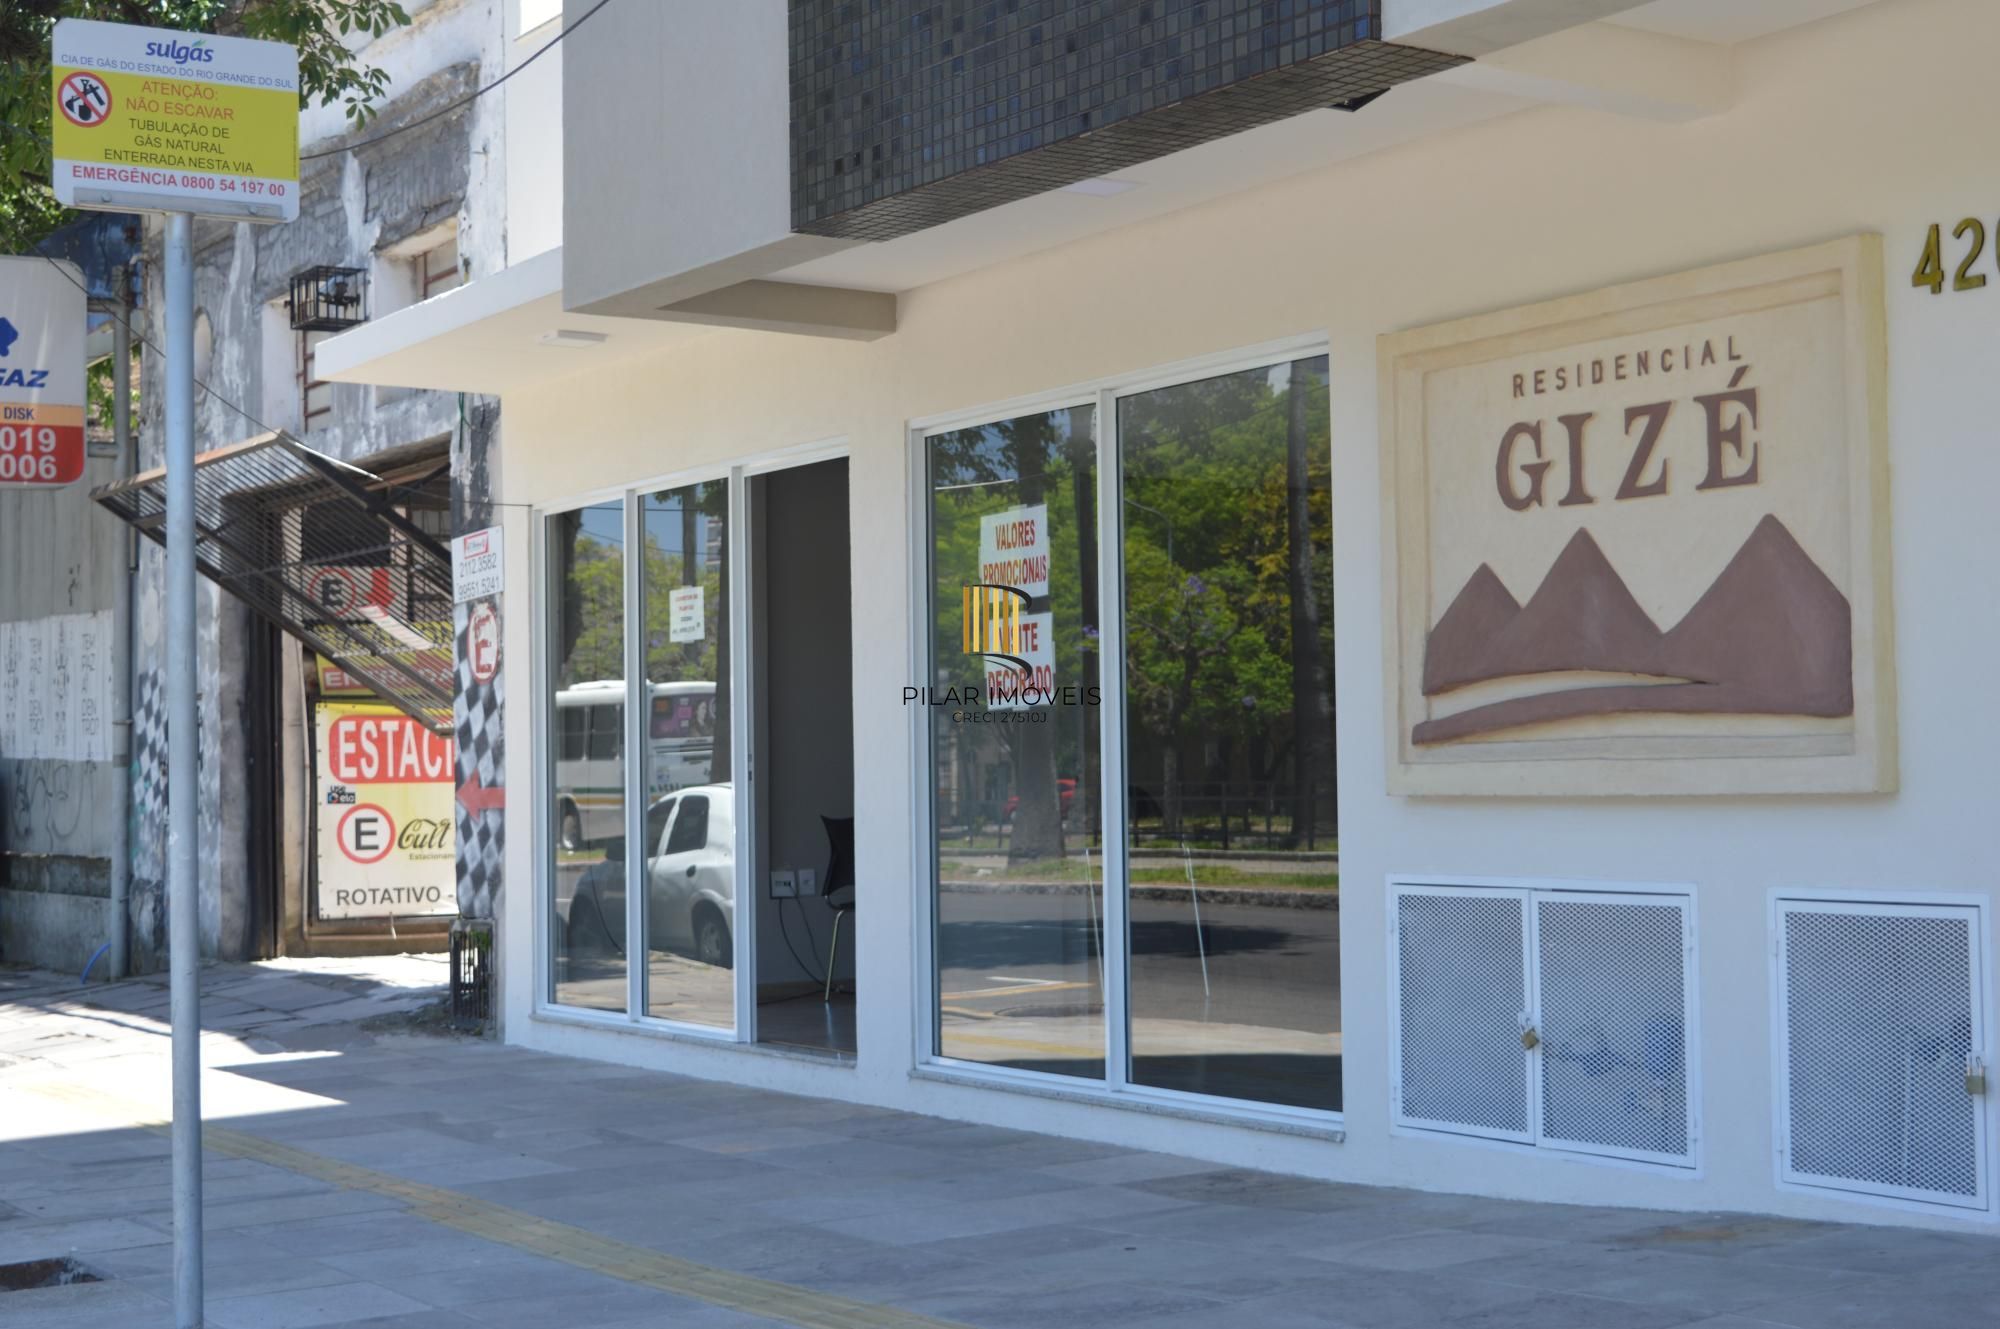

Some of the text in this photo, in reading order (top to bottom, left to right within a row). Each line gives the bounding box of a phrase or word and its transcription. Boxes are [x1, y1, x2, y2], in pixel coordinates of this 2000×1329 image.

[61, 54, 78, 64] CIA
[80, 57, 94, 66] DE
[120, 61, 135, 71] DO
[138, 63, 177, 76] ESTADO
[179, 67, 193, 77] DO
[196, 69, 213, 80] RIO
[216, 72, 256, 85] GRANDE
[258, 76, 272, 86] DO
[275, 79, 293, 89] SUL
[126, 97, 234, 121] NÃO ESCAVAR
[129, 118, 230, 139] TUBULAÇÃO DE
[134, 134, 225, 155] GÁS NATURAL
[104, 148, 255, 174] ENTERRADA NESTA VIA
[72, 165, 286, 197] EMERGÊNCIA 0800 54 197 00
[1912, 217, 2000, 294] 42
[1513, 335, 1743, 398] RESIDENCIAL
[4, 407, 34, 420] DISK
[0, 426, 57, 453] 019
[1495, 364, 1761, 513] GIZÉ
[0, 453, 57, 480] 006
[995, 519, 1036, 551] VALORES
[983, 555, 1048, 585] PROMOCIONAIS
[355, 818, 379, 850] E
[336, 886, 441, 906] ROTATIVO
